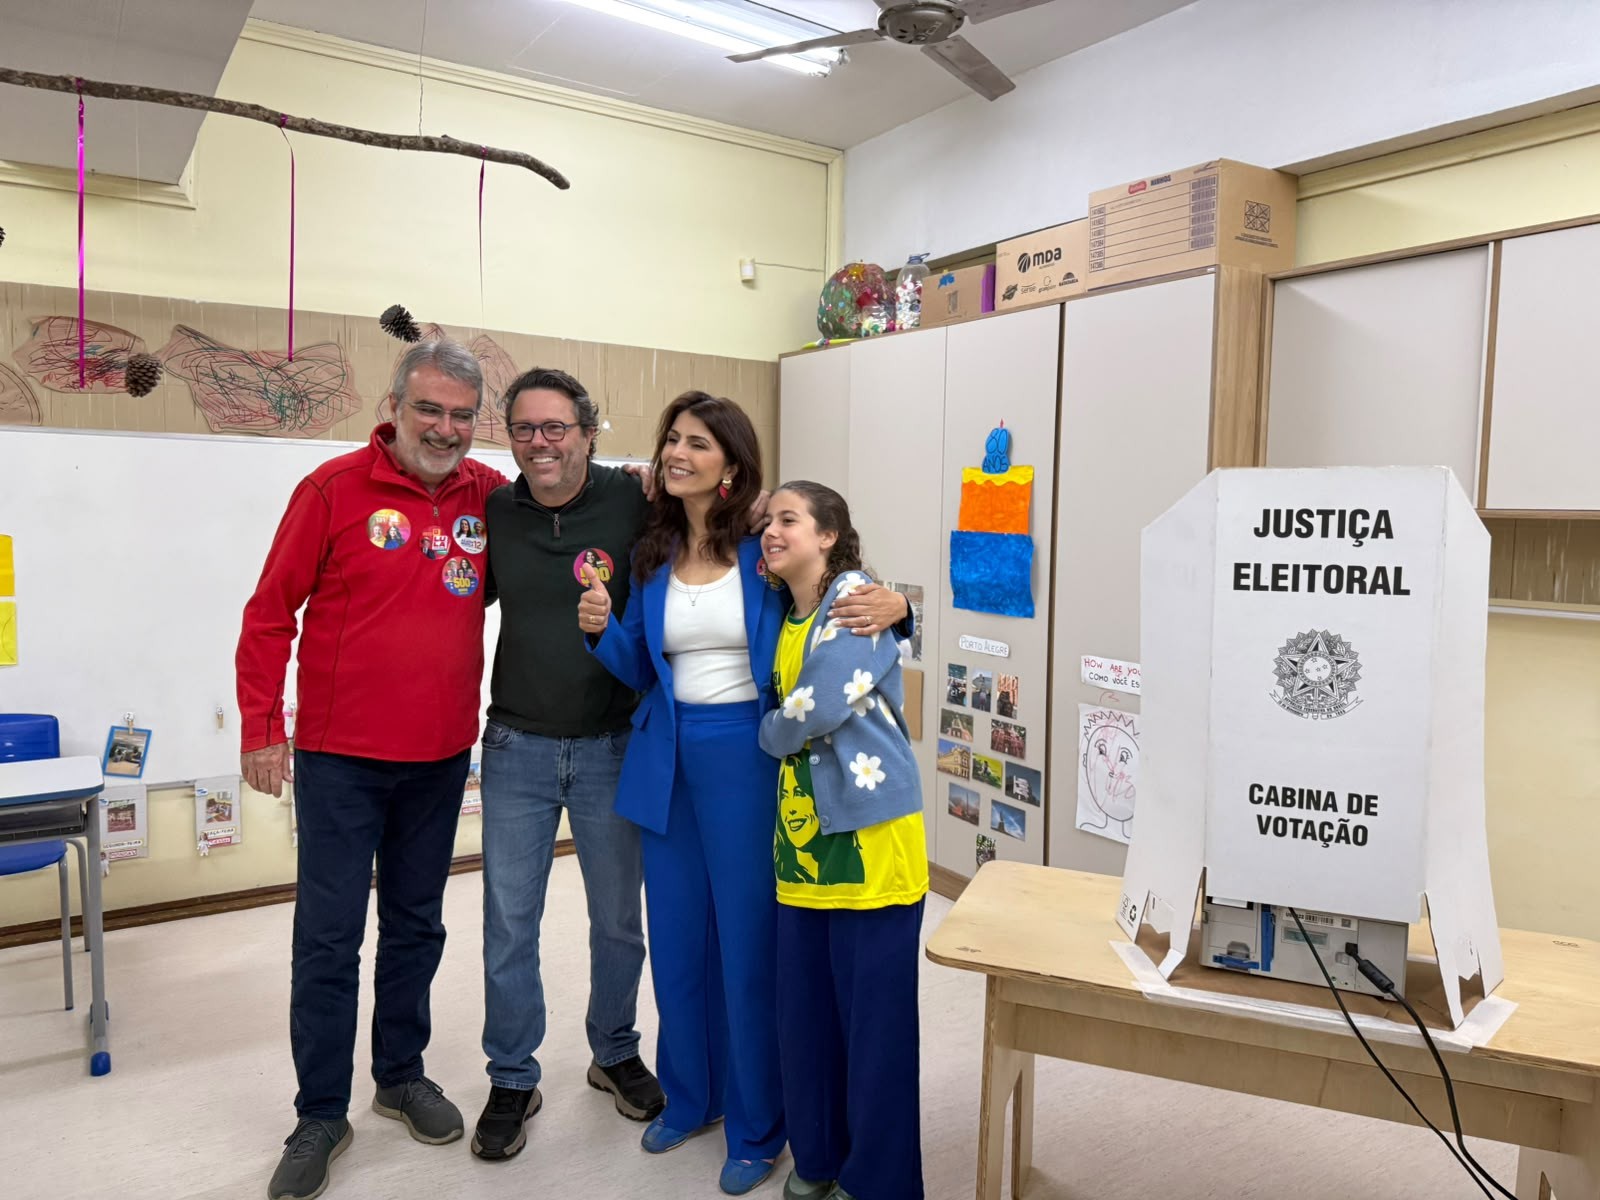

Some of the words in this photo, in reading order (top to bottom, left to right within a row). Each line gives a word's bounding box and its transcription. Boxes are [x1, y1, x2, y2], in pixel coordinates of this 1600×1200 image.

[1253, 508, 1394, 547] JUSTIÇA
[453, 577, 471, 588] 500
[1232, 562, 1411, 596] ELEITORAL
[1083, 658, 1103, 669] HOW
[1110, 664, 1122, 673] ARE
[1088, 672, 1109, 682] COMO
[1248, 782, 1339, 813] CABINA
[1347, 792, 1379, 817] DE
[1256, 814, 1369, 848] VOTAÇÃO
